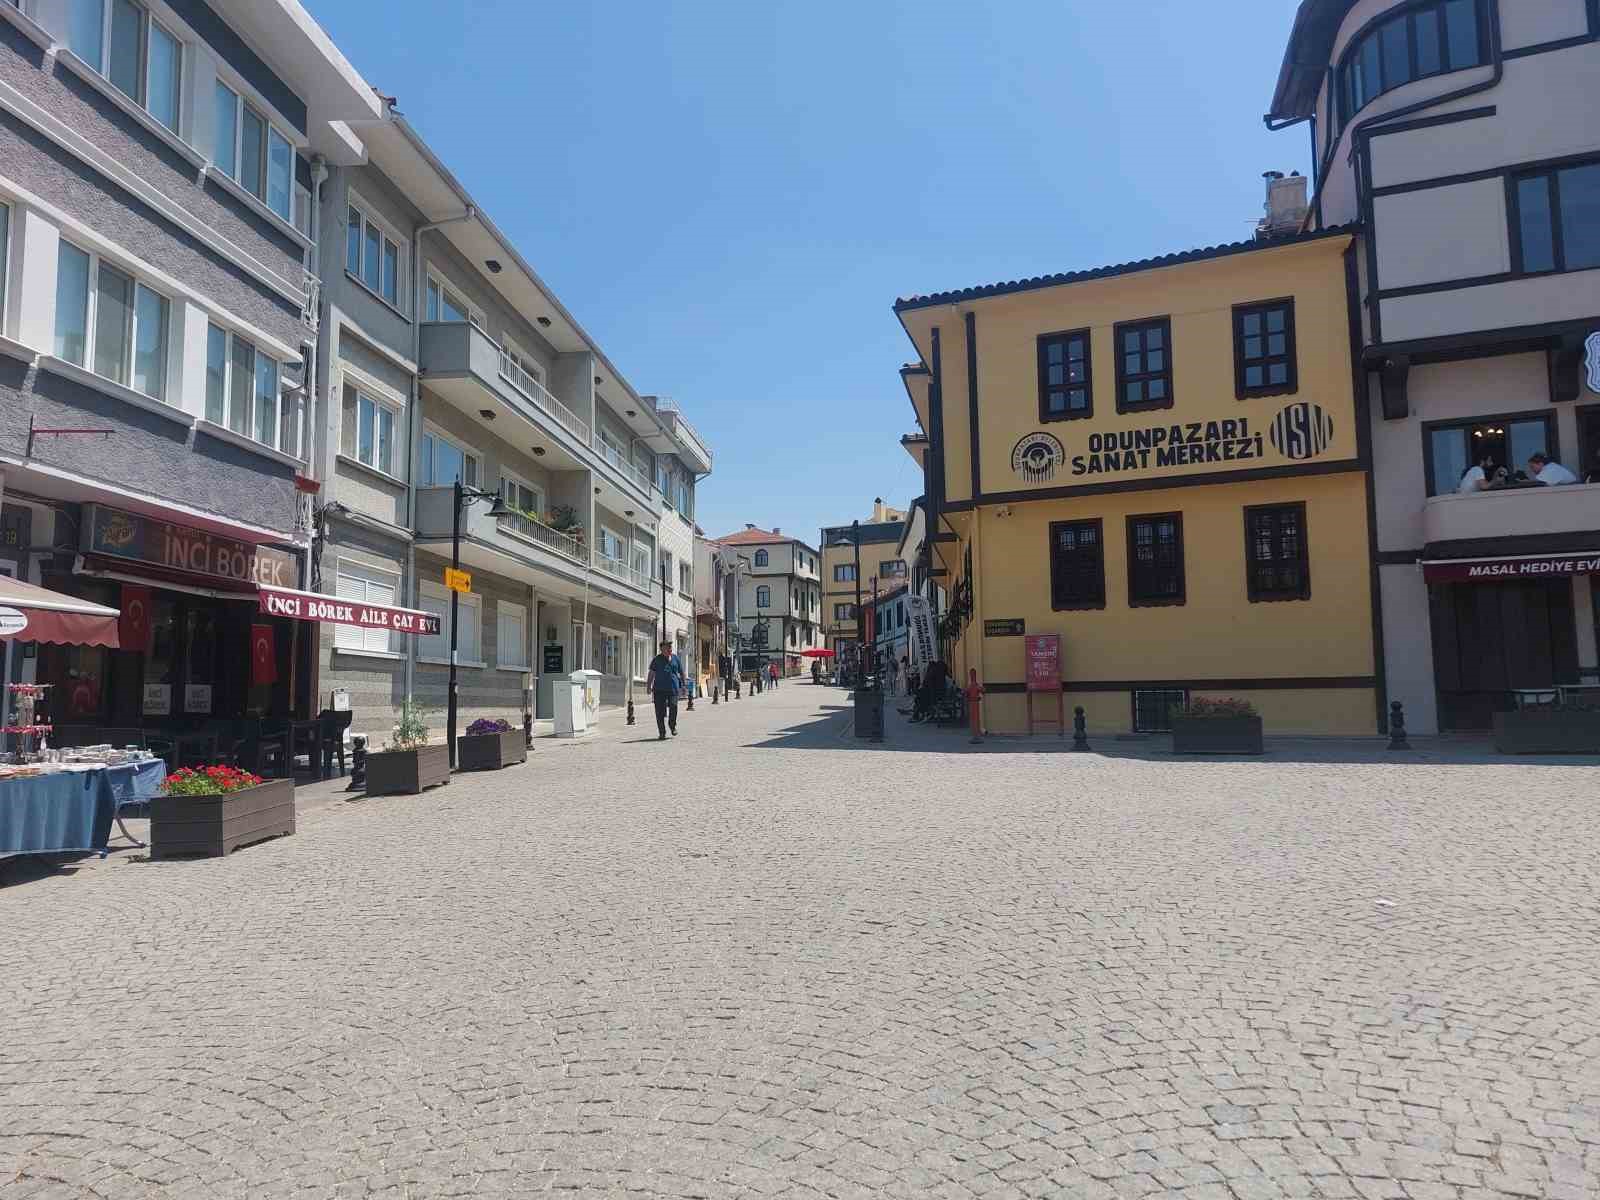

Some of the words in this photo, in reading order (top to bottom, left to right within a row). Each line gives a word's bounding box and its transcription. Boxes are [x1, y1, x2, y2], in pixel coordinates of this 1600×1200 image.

[1088, 417, 1248, 453] ODUNPAZARI
[1071, 449, 1151, 475] SANAT
[1156, 432, 1264, 468] MERKEZİ
[163, 525, 211, 569] İNCİ
[217, 543, 284, 585] BÖREK
[1469, 564, 1517, 576] MASAL
[1520, 560, 1574, 573] HEDİYE
[267, 594, 300, 615] İNCİ
[309, 601, 353, 621] BÖREK
[360, 607, 388, 625] AİLE
[393, 613, 414, 628] ÇAY
